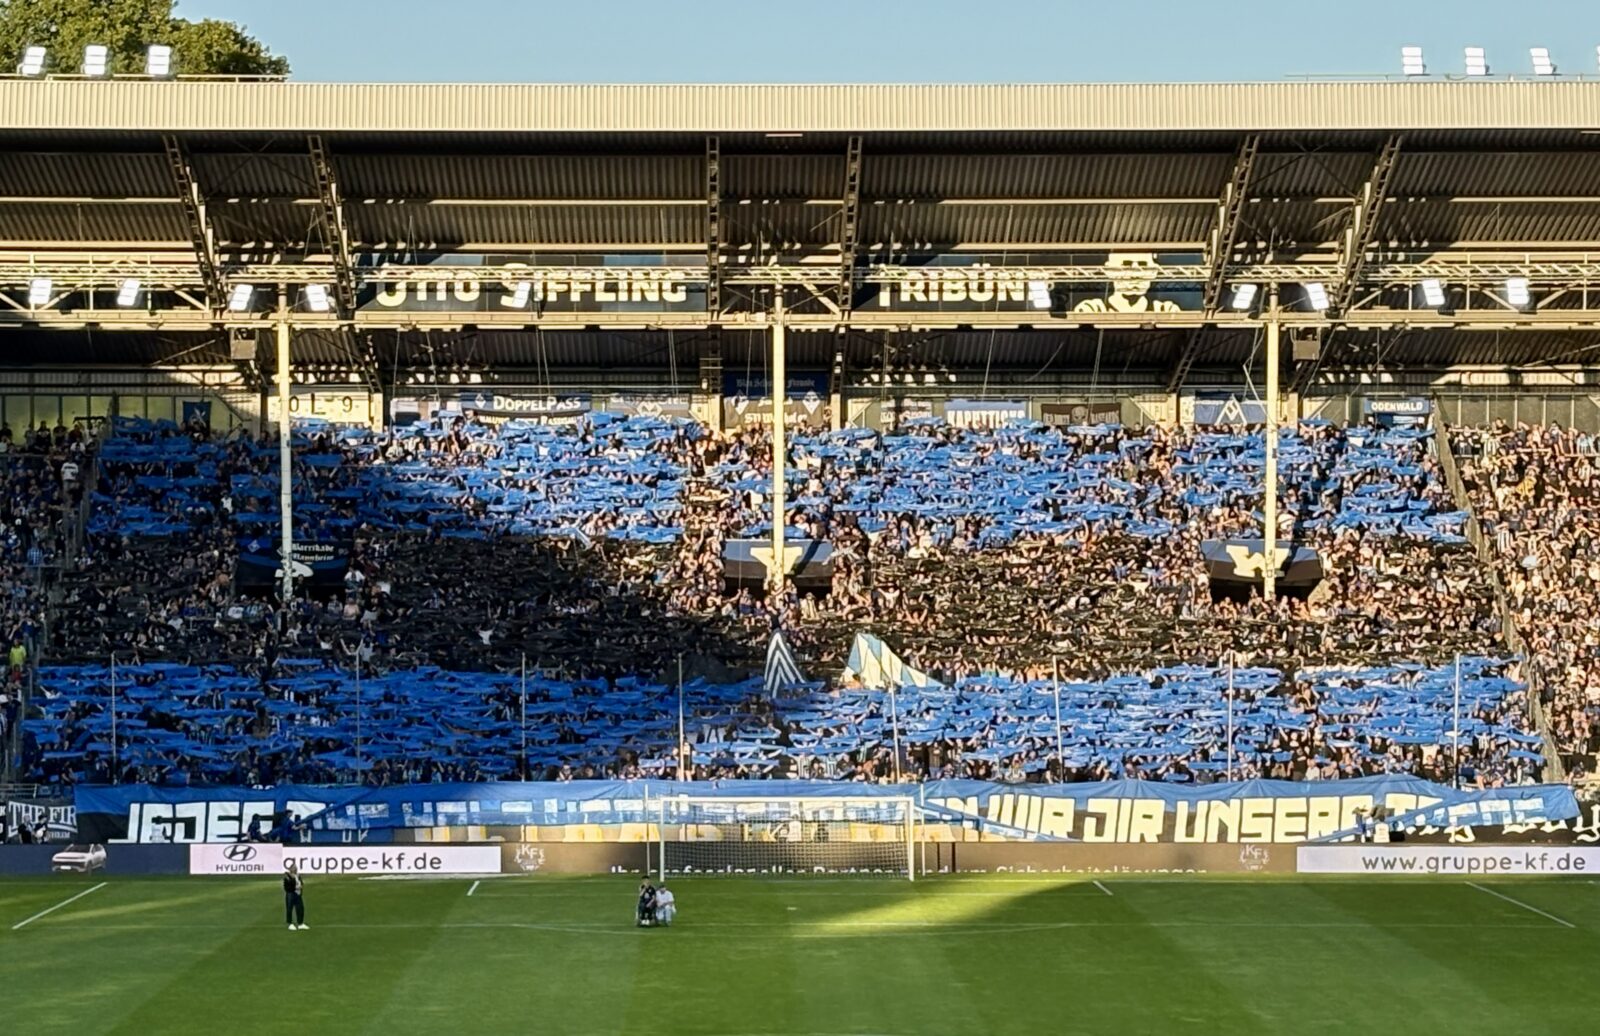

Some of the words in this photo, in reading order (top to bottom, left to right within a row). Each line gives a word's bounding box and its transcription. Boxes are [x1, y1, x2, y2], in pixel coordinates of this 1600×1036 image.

[376, 263, 480, 307] OTTO
[877, 263, 1051, 307] TRIBÜN
[1371, 402, 1423, 411] ODENWALD
[1083, 797, 1165, 843] DIR
[215, 864, 264, 872] HYUNDAI
[283, 852, 442, 873] gruppe-kf.de
[1362, 852, 1586, 873] www.gruppe-kf.de
